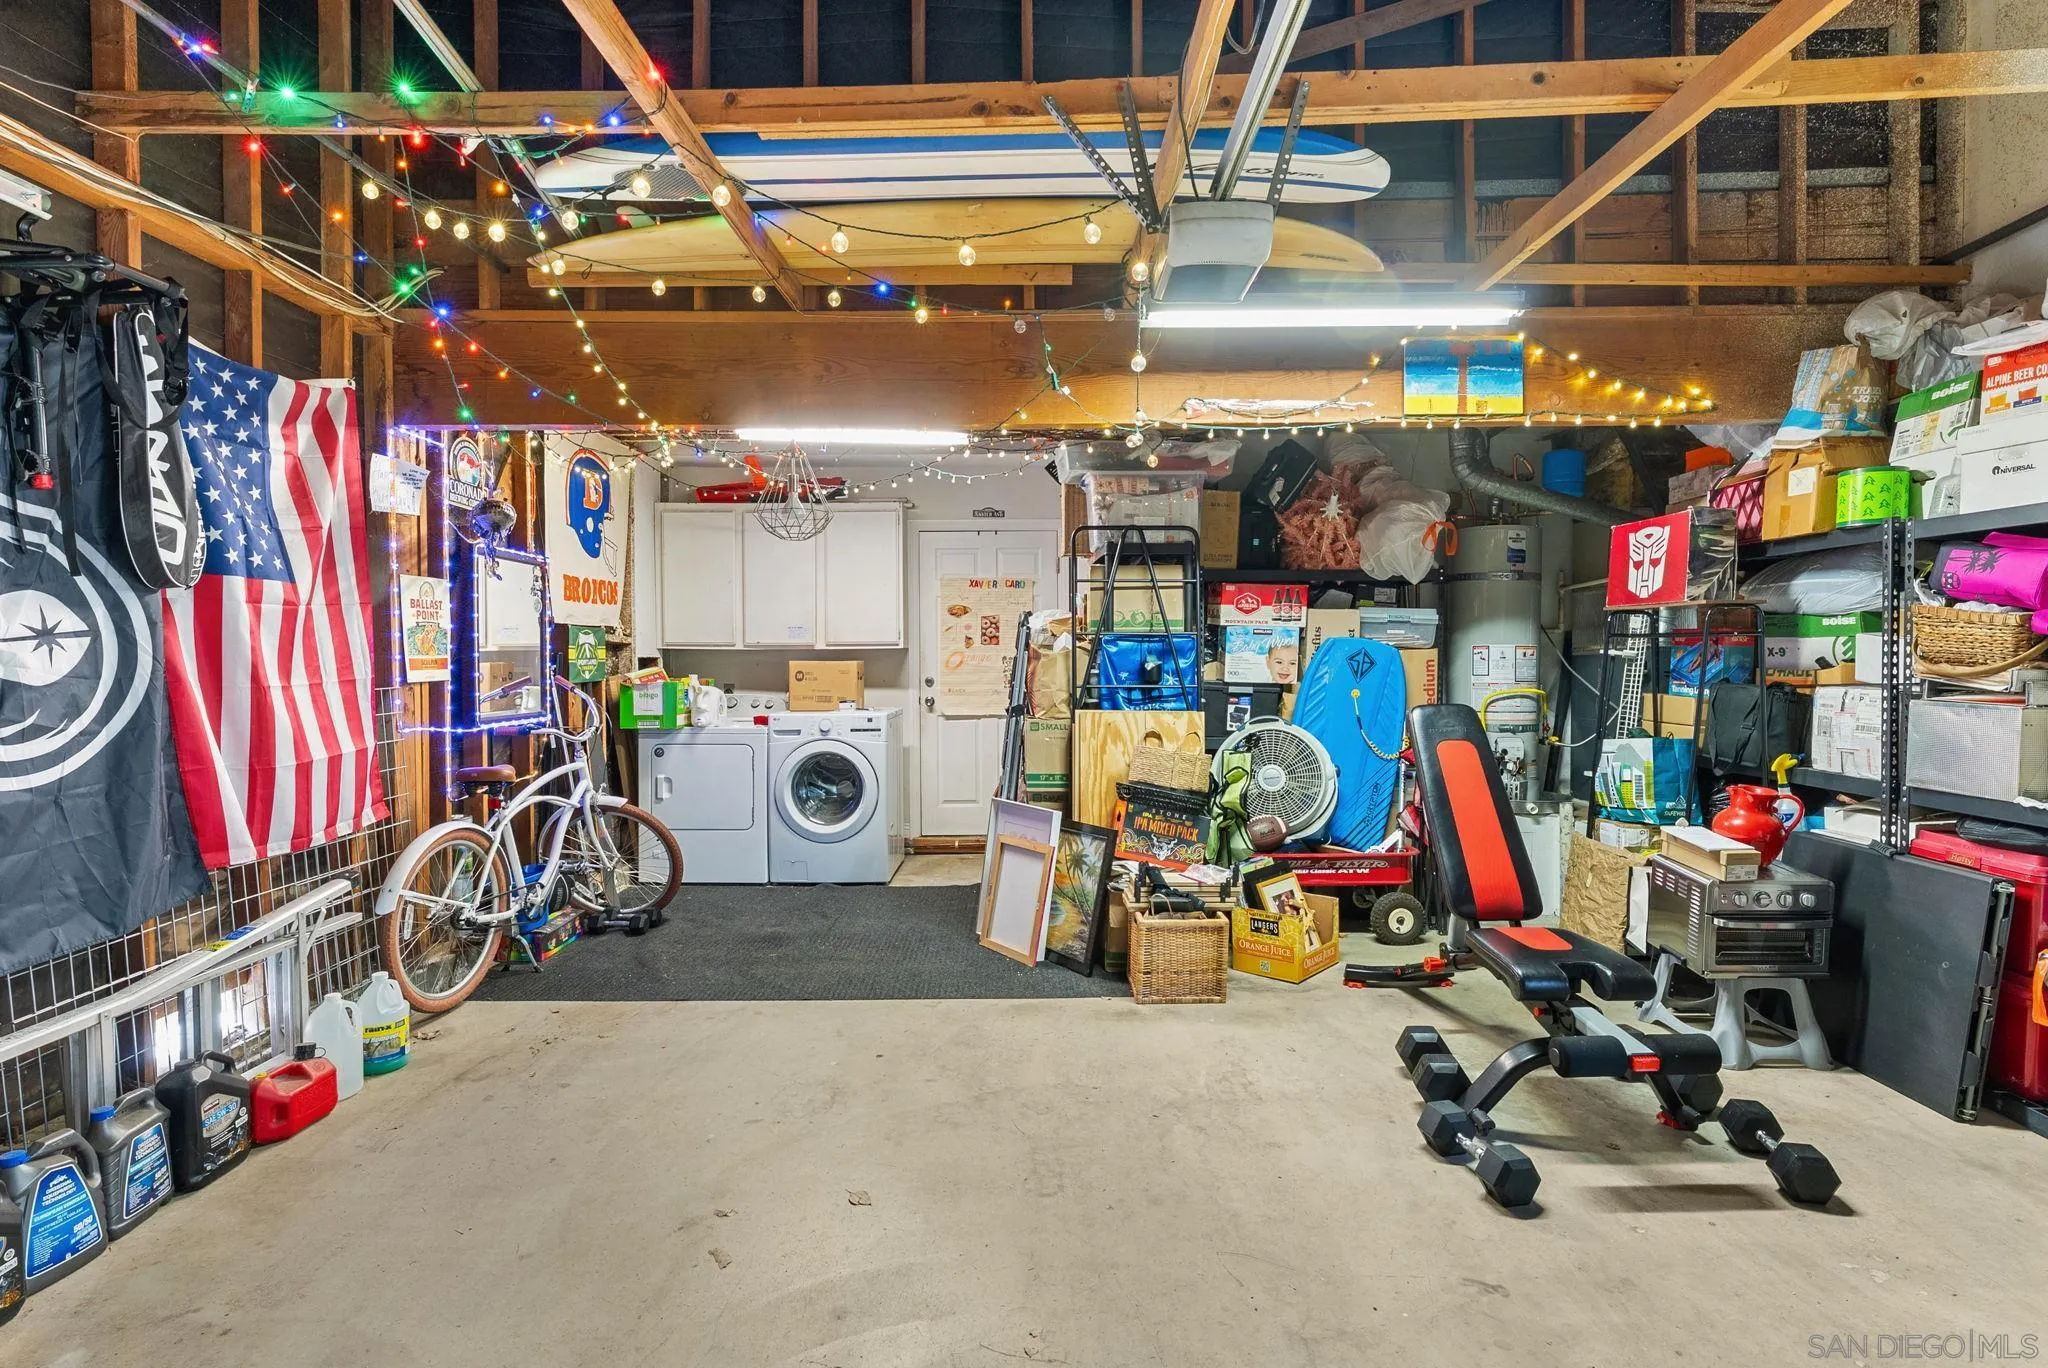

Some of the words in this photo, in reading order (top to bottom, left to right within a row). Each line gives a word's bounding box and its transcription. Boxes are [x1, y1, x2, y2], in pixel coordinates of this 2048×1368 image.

[1985, 373, 2012, 388] ALPINE
[2013, 366, 2034, 380] BEER
[563, 574, 618, 605] BRONCOS
[410, 598, 443, 610] BALLAST
[416, 610, 439, 620] POINT
[1424, 659, 1435, 705] edium
[1040, 723, 1068, 731] SMALL
[1152, 808, 1187, 820] STONE
[1134, 816, 1148, 831] IPA
[1149, 820, 1176, 837] MIXED
[1176, 824, 1199, 841] PACK
[1251, 919, 1278, 934] LANGERS
[1239, 939, 1270, 953] ORANGE
[1270, 944, 1292, 957] JUICE
[1303, 953, 1324, 968] ORANGE
[1323, 946, 1336, 961] JUICE
[43, 1182, 75, 1201] EQUIPMENT
[46, 1179, 73, 1194] ORIGINAL
[41, 1186, 77, 1207] TECHNOLOGY
[73, 1214, 93, 1233] 50/50
